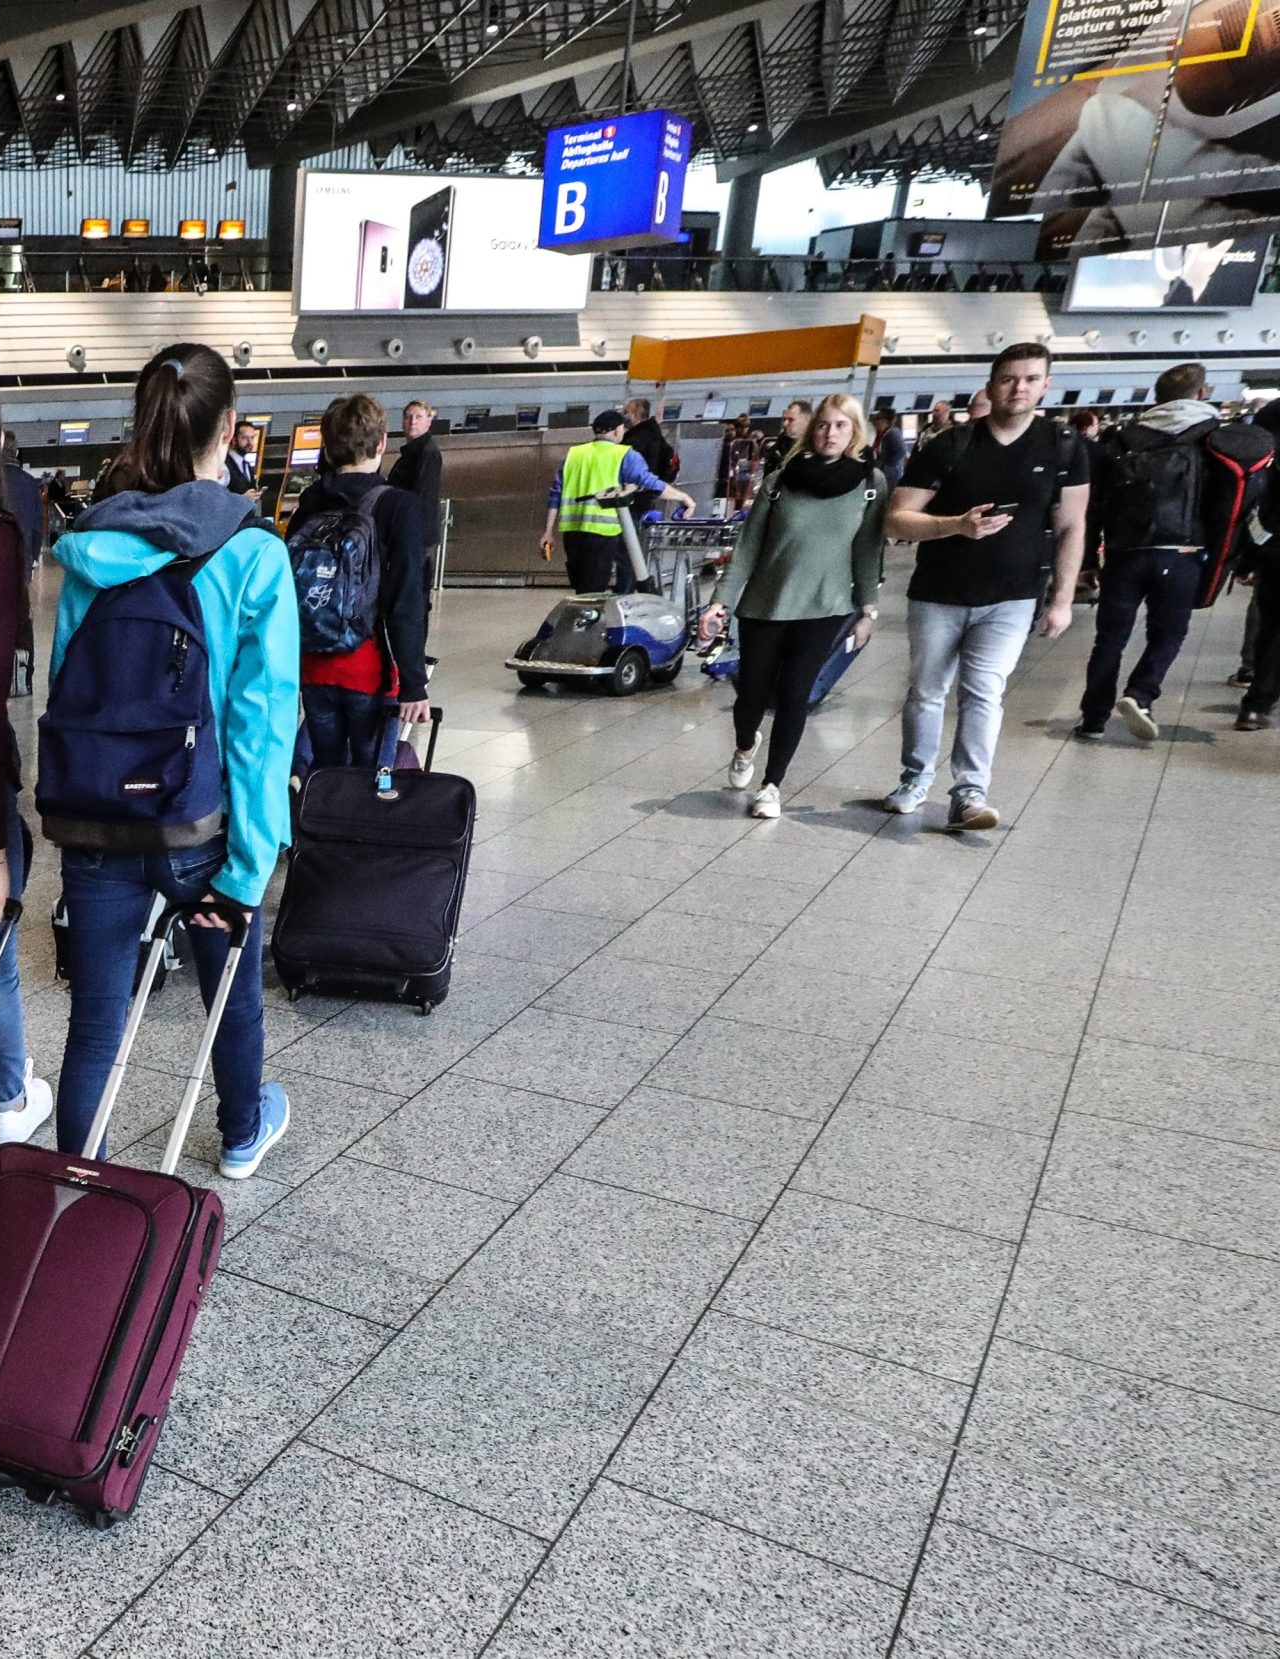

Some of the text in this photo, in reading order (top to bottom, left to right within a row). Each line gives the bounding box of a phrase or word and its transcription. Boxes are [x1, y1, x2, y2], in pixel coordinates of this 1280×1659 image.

[1055, 9, 1172, 38] capture value?
[1057, 4, 1126, 26] platform,
[1128, 0, 1159, 13] who
[561, 140, 615, 158] Abflughalle
[563, 128, 603, 145] Terminal
[560, 147, 631, 171] Departures hall
[554, 180, 588, 236] B
[654, 170, 670, 225] B
[124, 783, 158, 791] EASTPAK
